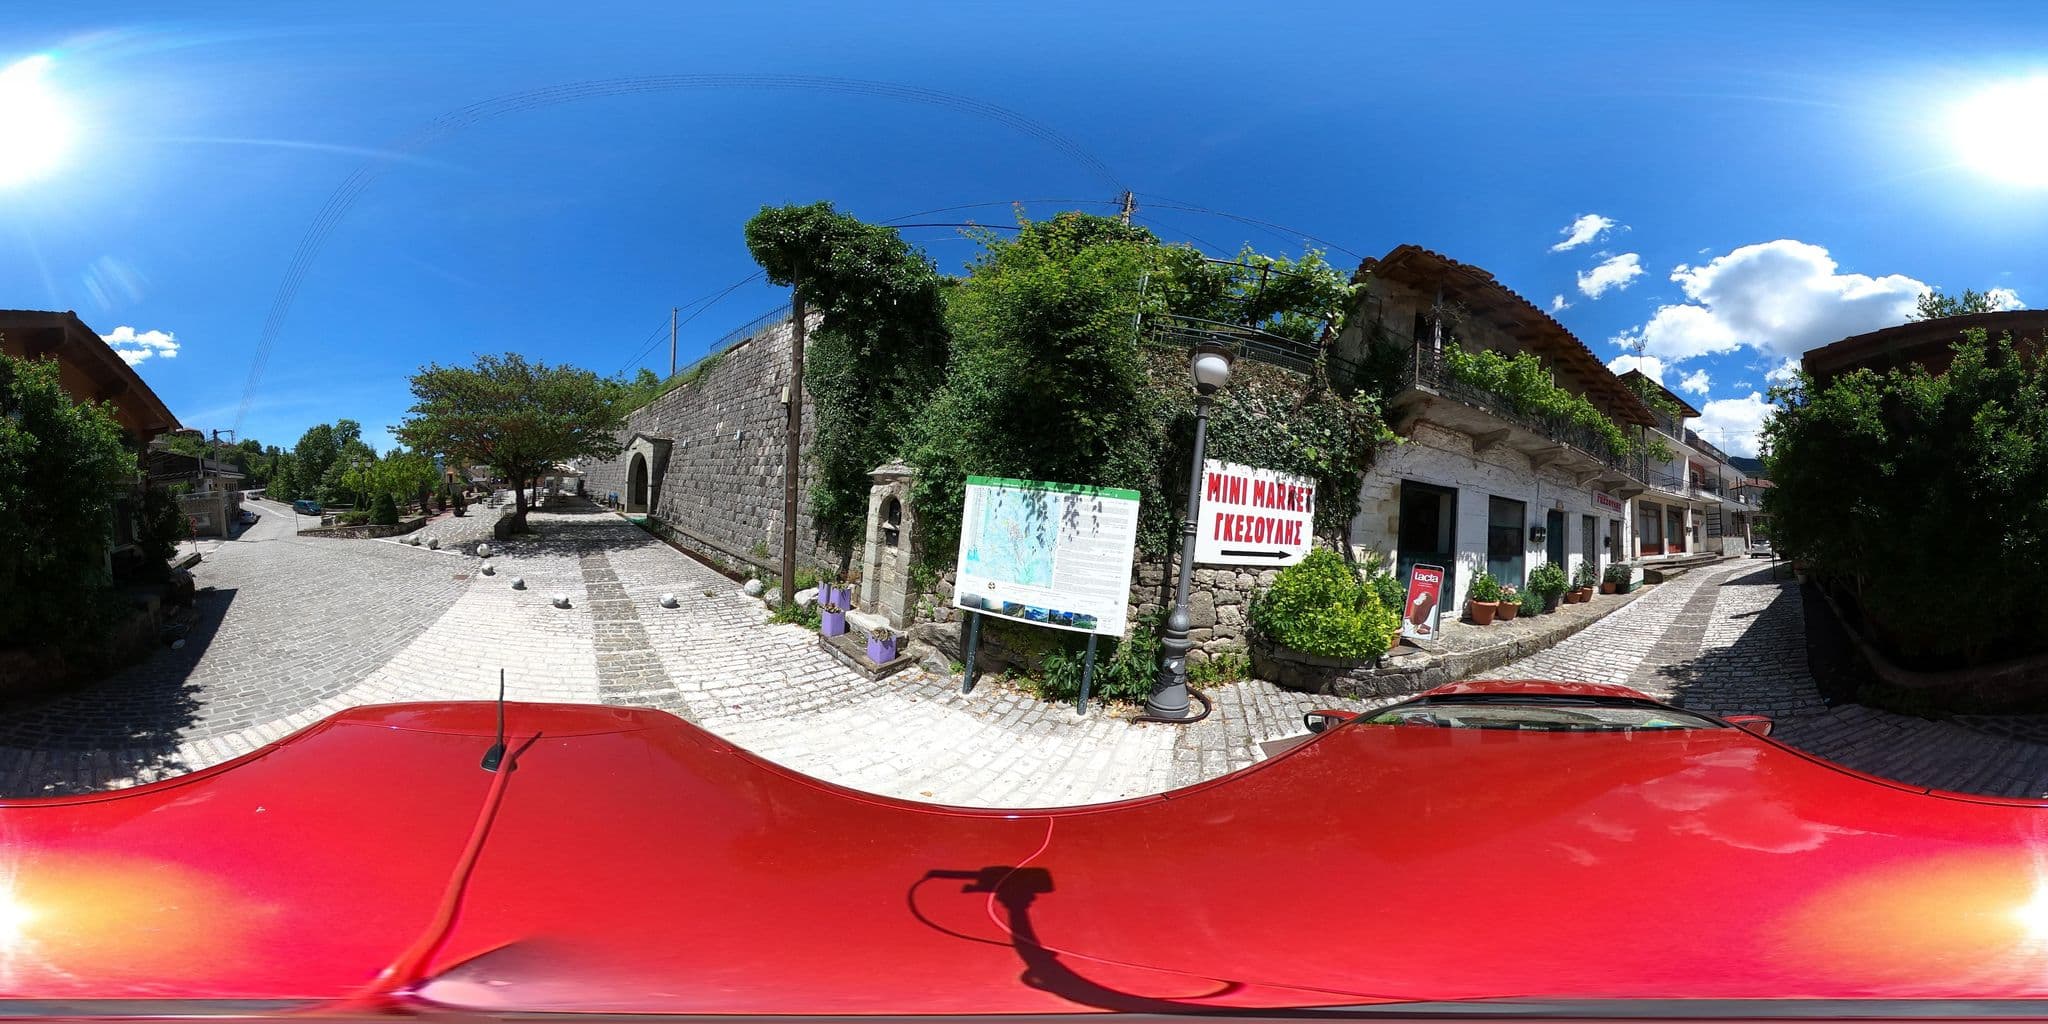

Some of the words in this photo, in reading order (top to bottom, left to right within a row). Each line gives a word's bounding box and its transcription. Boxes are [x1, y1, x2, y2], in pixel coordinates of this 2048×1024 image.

[1207, 472, 1248, 505] MINI
[1253, 479, 1312, 513] MARKET
[1214, 512, 1302, 546] ΓΚΕΣΟΥΛΗΣ
